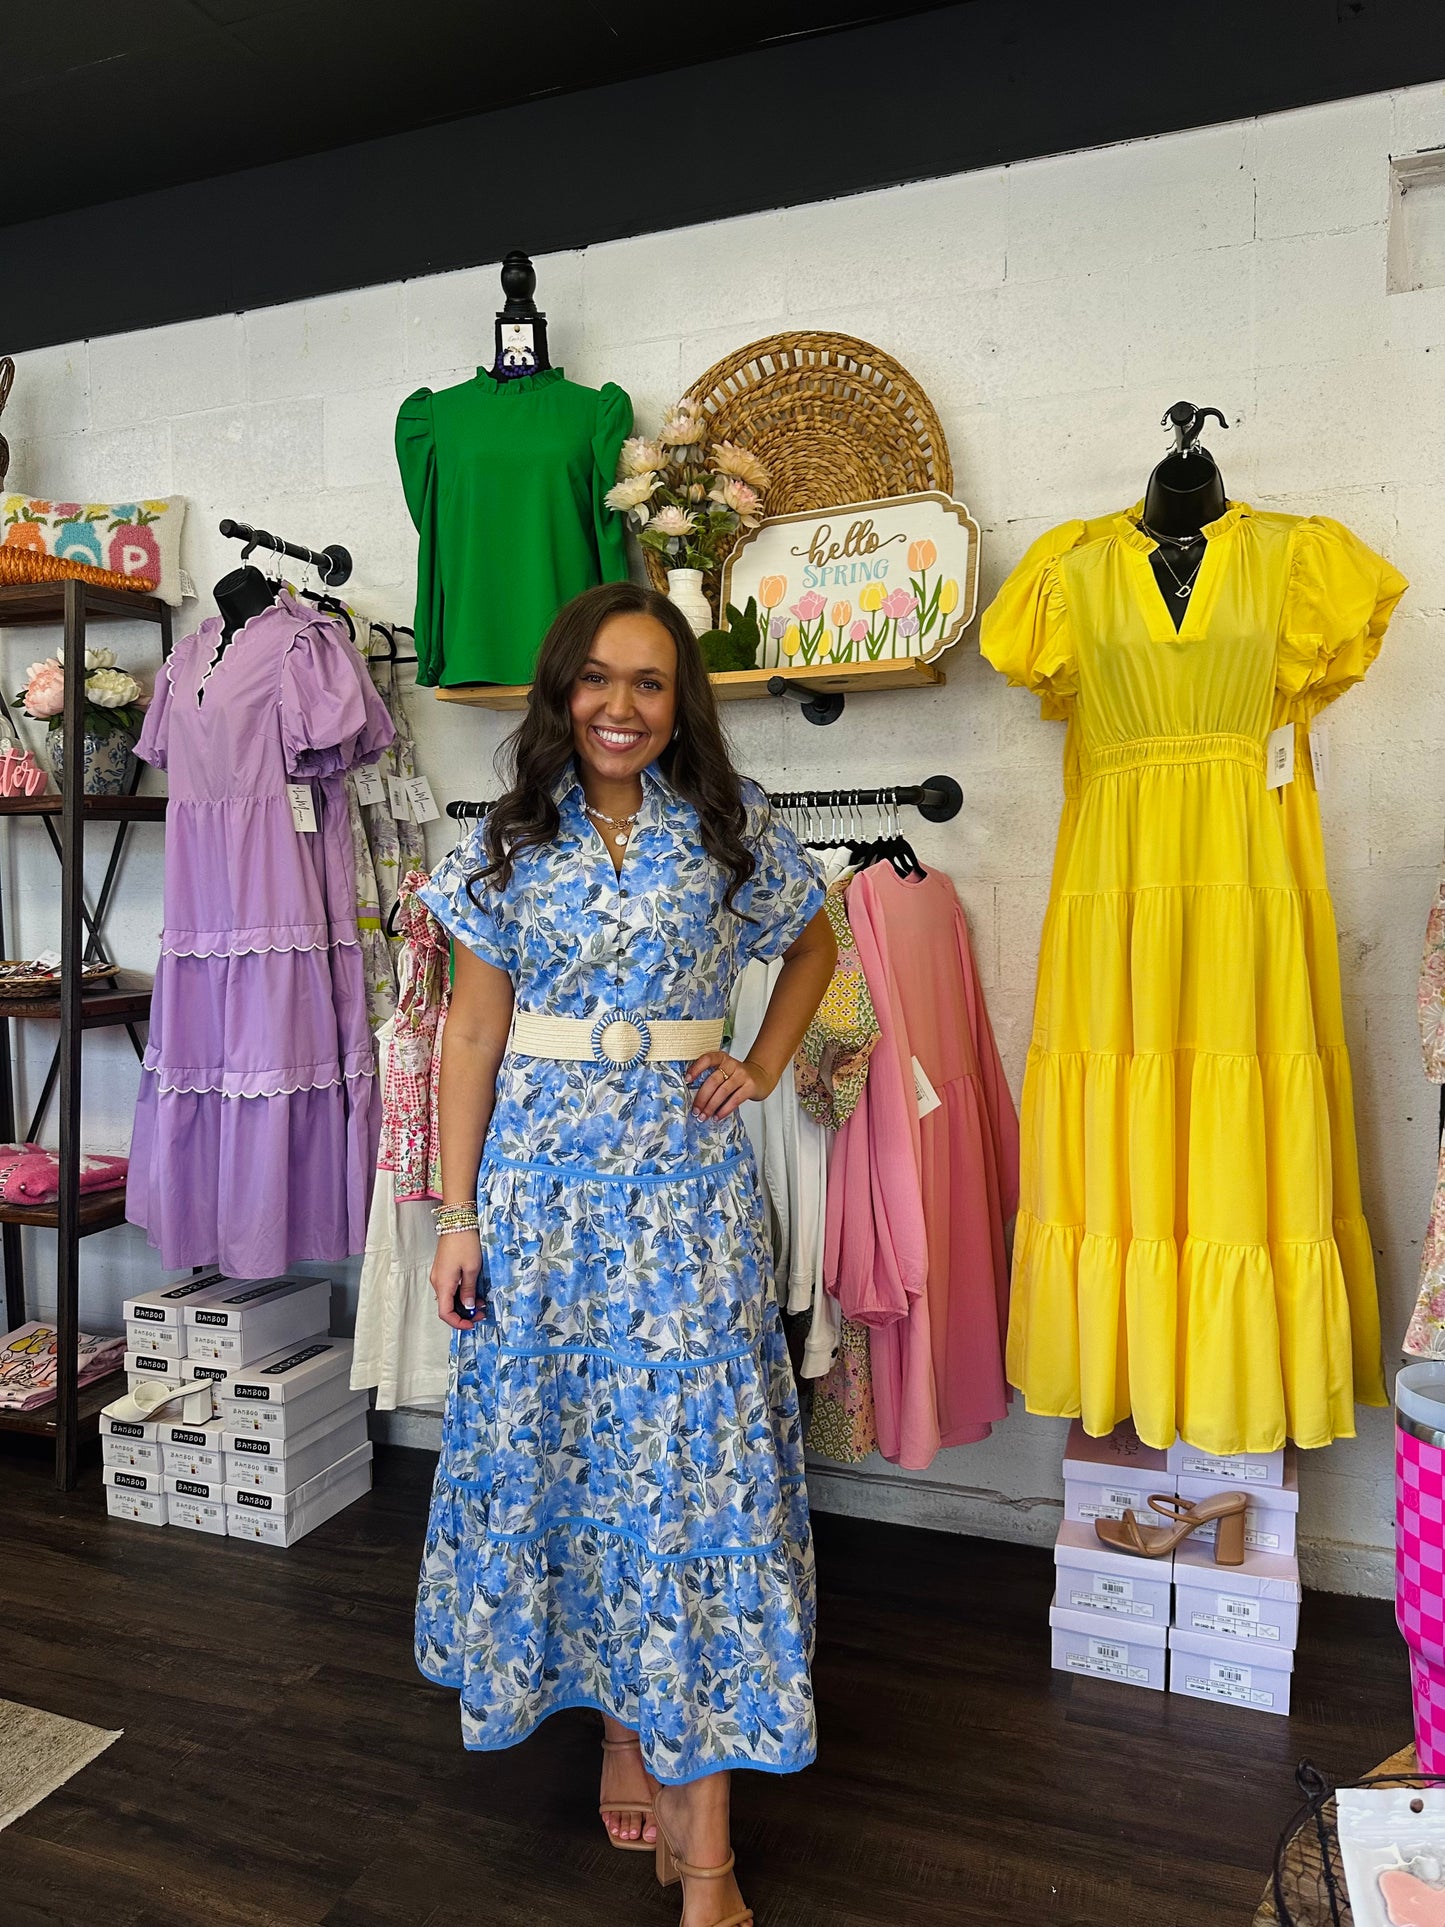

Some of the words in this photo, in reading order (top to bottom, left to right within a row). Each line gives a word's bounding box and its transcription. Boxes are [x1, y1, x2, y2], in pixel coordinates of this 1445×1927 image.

[790, 518, 907, 567] hello
[802, 558, 890, 589] SPRING
[135, 1309, 164, 1320] BAMBOO
[197, 1313, 226, 1324] BAMBOO
[137, 1359, 166, 1370] BAMBOO
[195, 1369, 225, 1380] BAMBOO
[236, 1387, 267, 1397] BAMBOO
[112, 1424, 142, 1436] BAMBOO
[173, 1432, 204, 1443] BAMBOO
[236, 1440, 268, 1452] BAMBOO
[116, 1475, 145, 1487] BAMBOO
[177, 1483, 207, 1495] BAMBOO
[239, 1494, 270, 1507] BAMBOO
